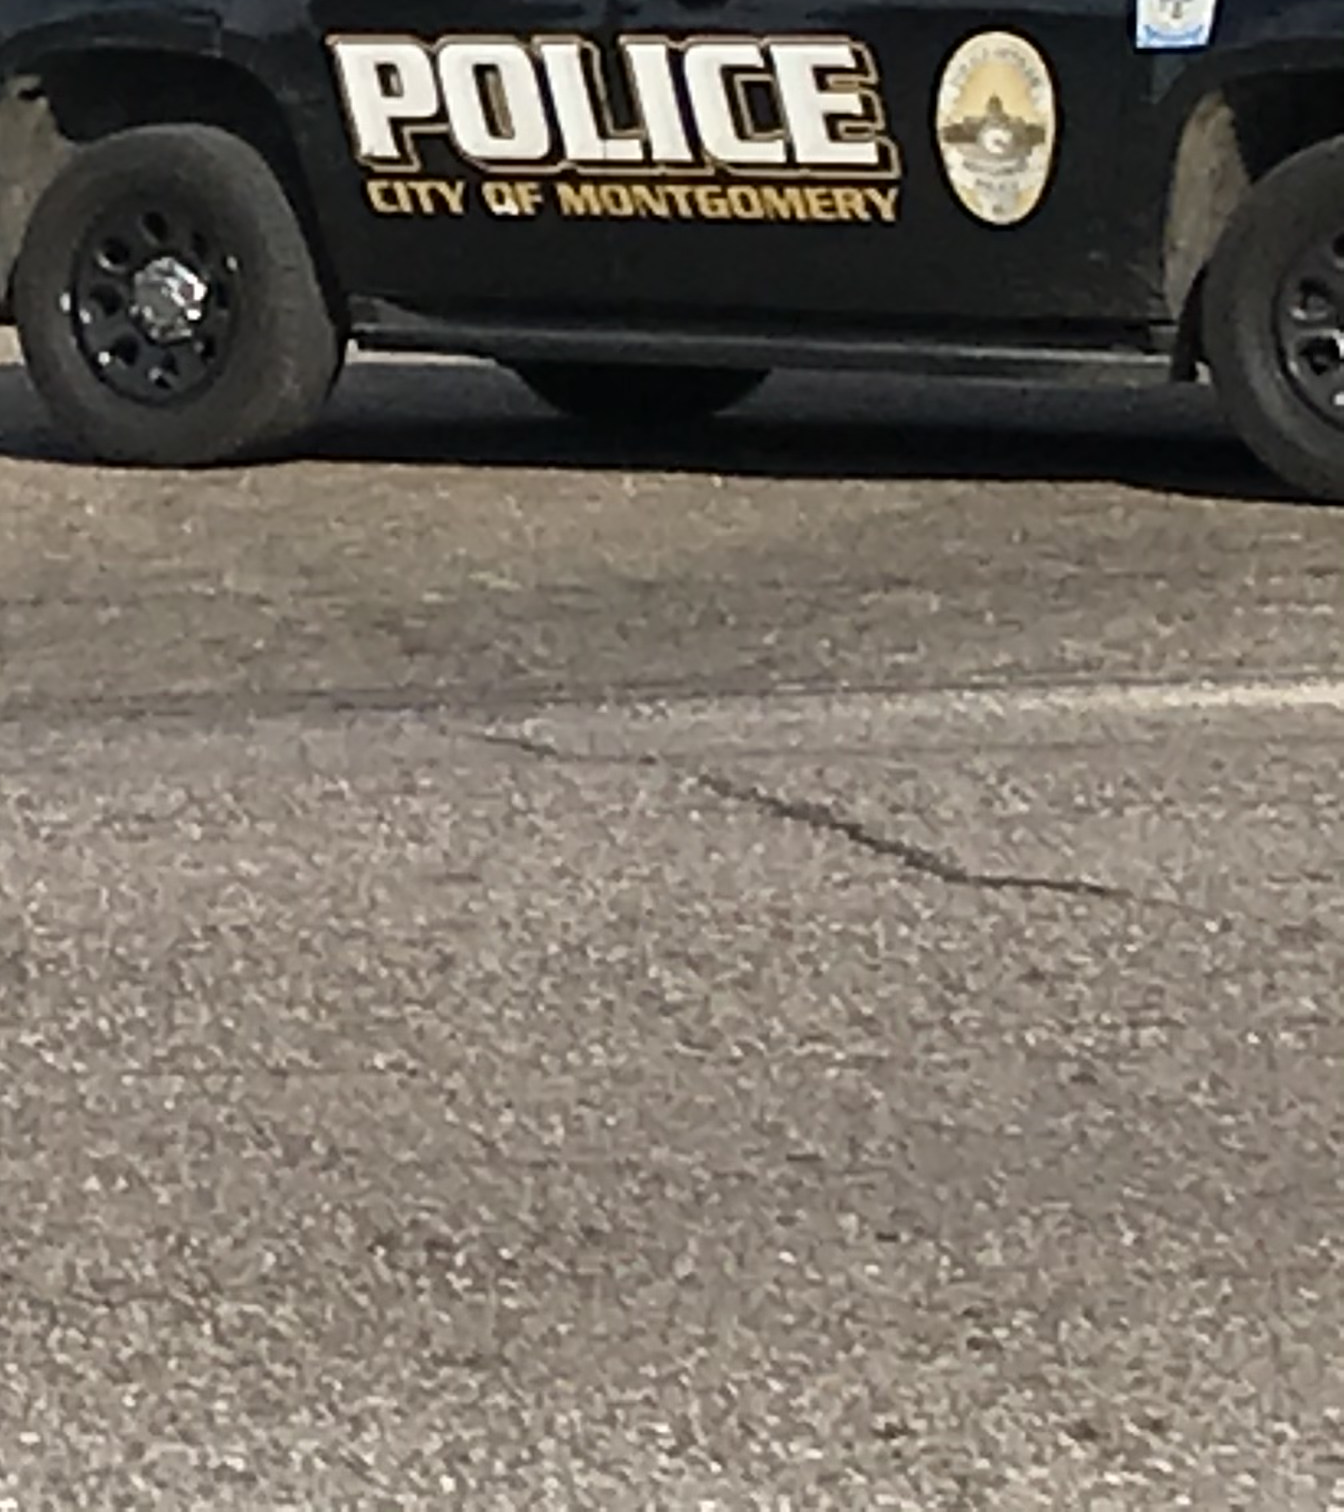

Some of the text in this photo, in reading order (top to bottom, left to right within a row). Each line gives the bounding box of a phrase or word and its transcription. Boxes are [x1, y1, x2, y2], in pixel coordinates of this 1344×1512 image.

[327, 35, 899, 180] POLICE
[366, 178, 899, 223] CITY OF MONTGOMERY
